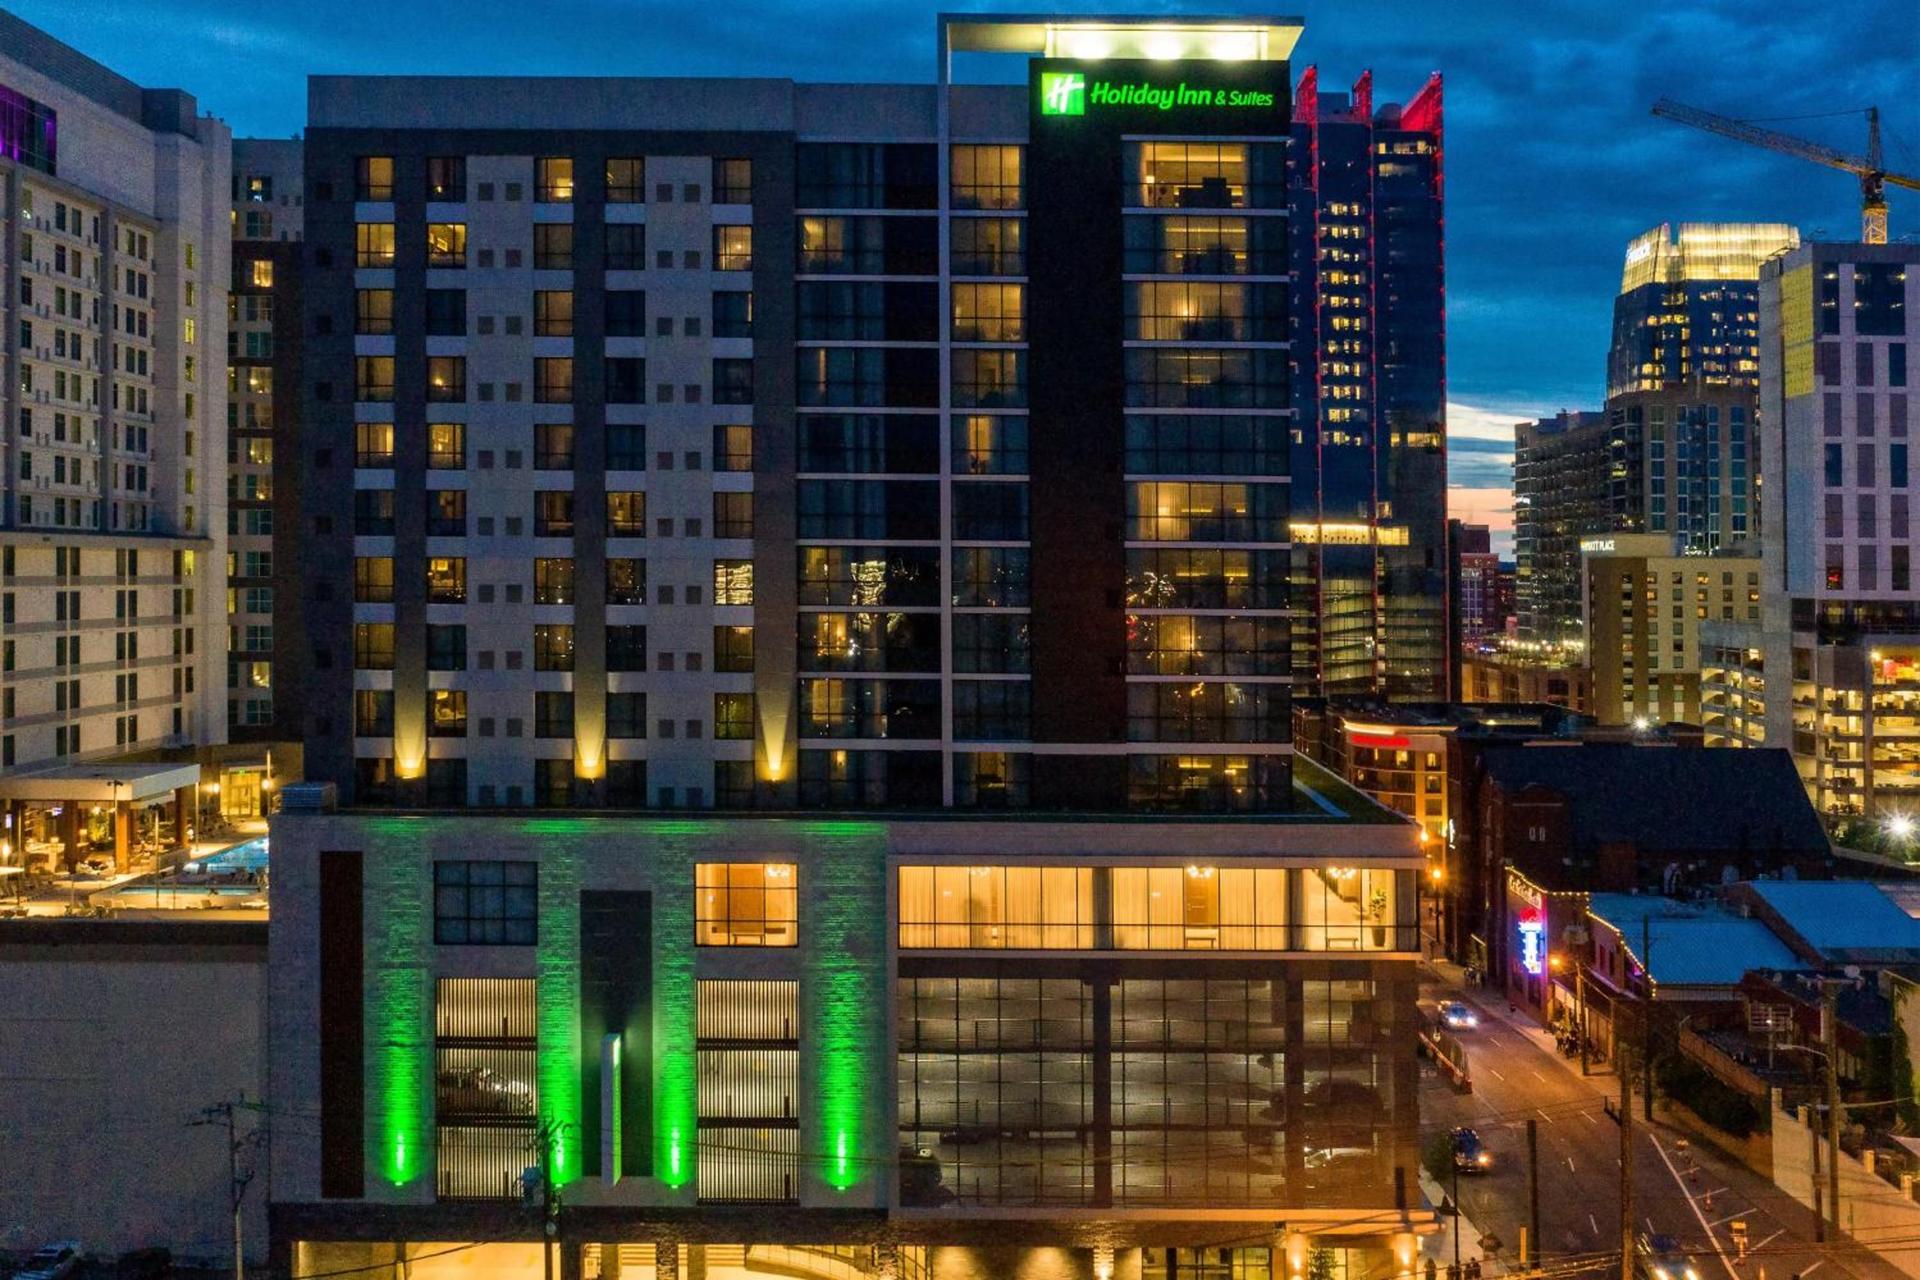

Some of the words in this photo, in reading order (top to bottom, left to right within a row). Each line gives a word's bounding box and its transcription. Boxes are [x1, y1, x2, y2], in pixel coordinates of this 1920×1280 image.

[1090, 82, 1175, 109] Holiday
[1177, 83, 1212, 105] Inn
[1214, 90, 1226, 106] &
[1227, 90, 1274, 106] Suites
